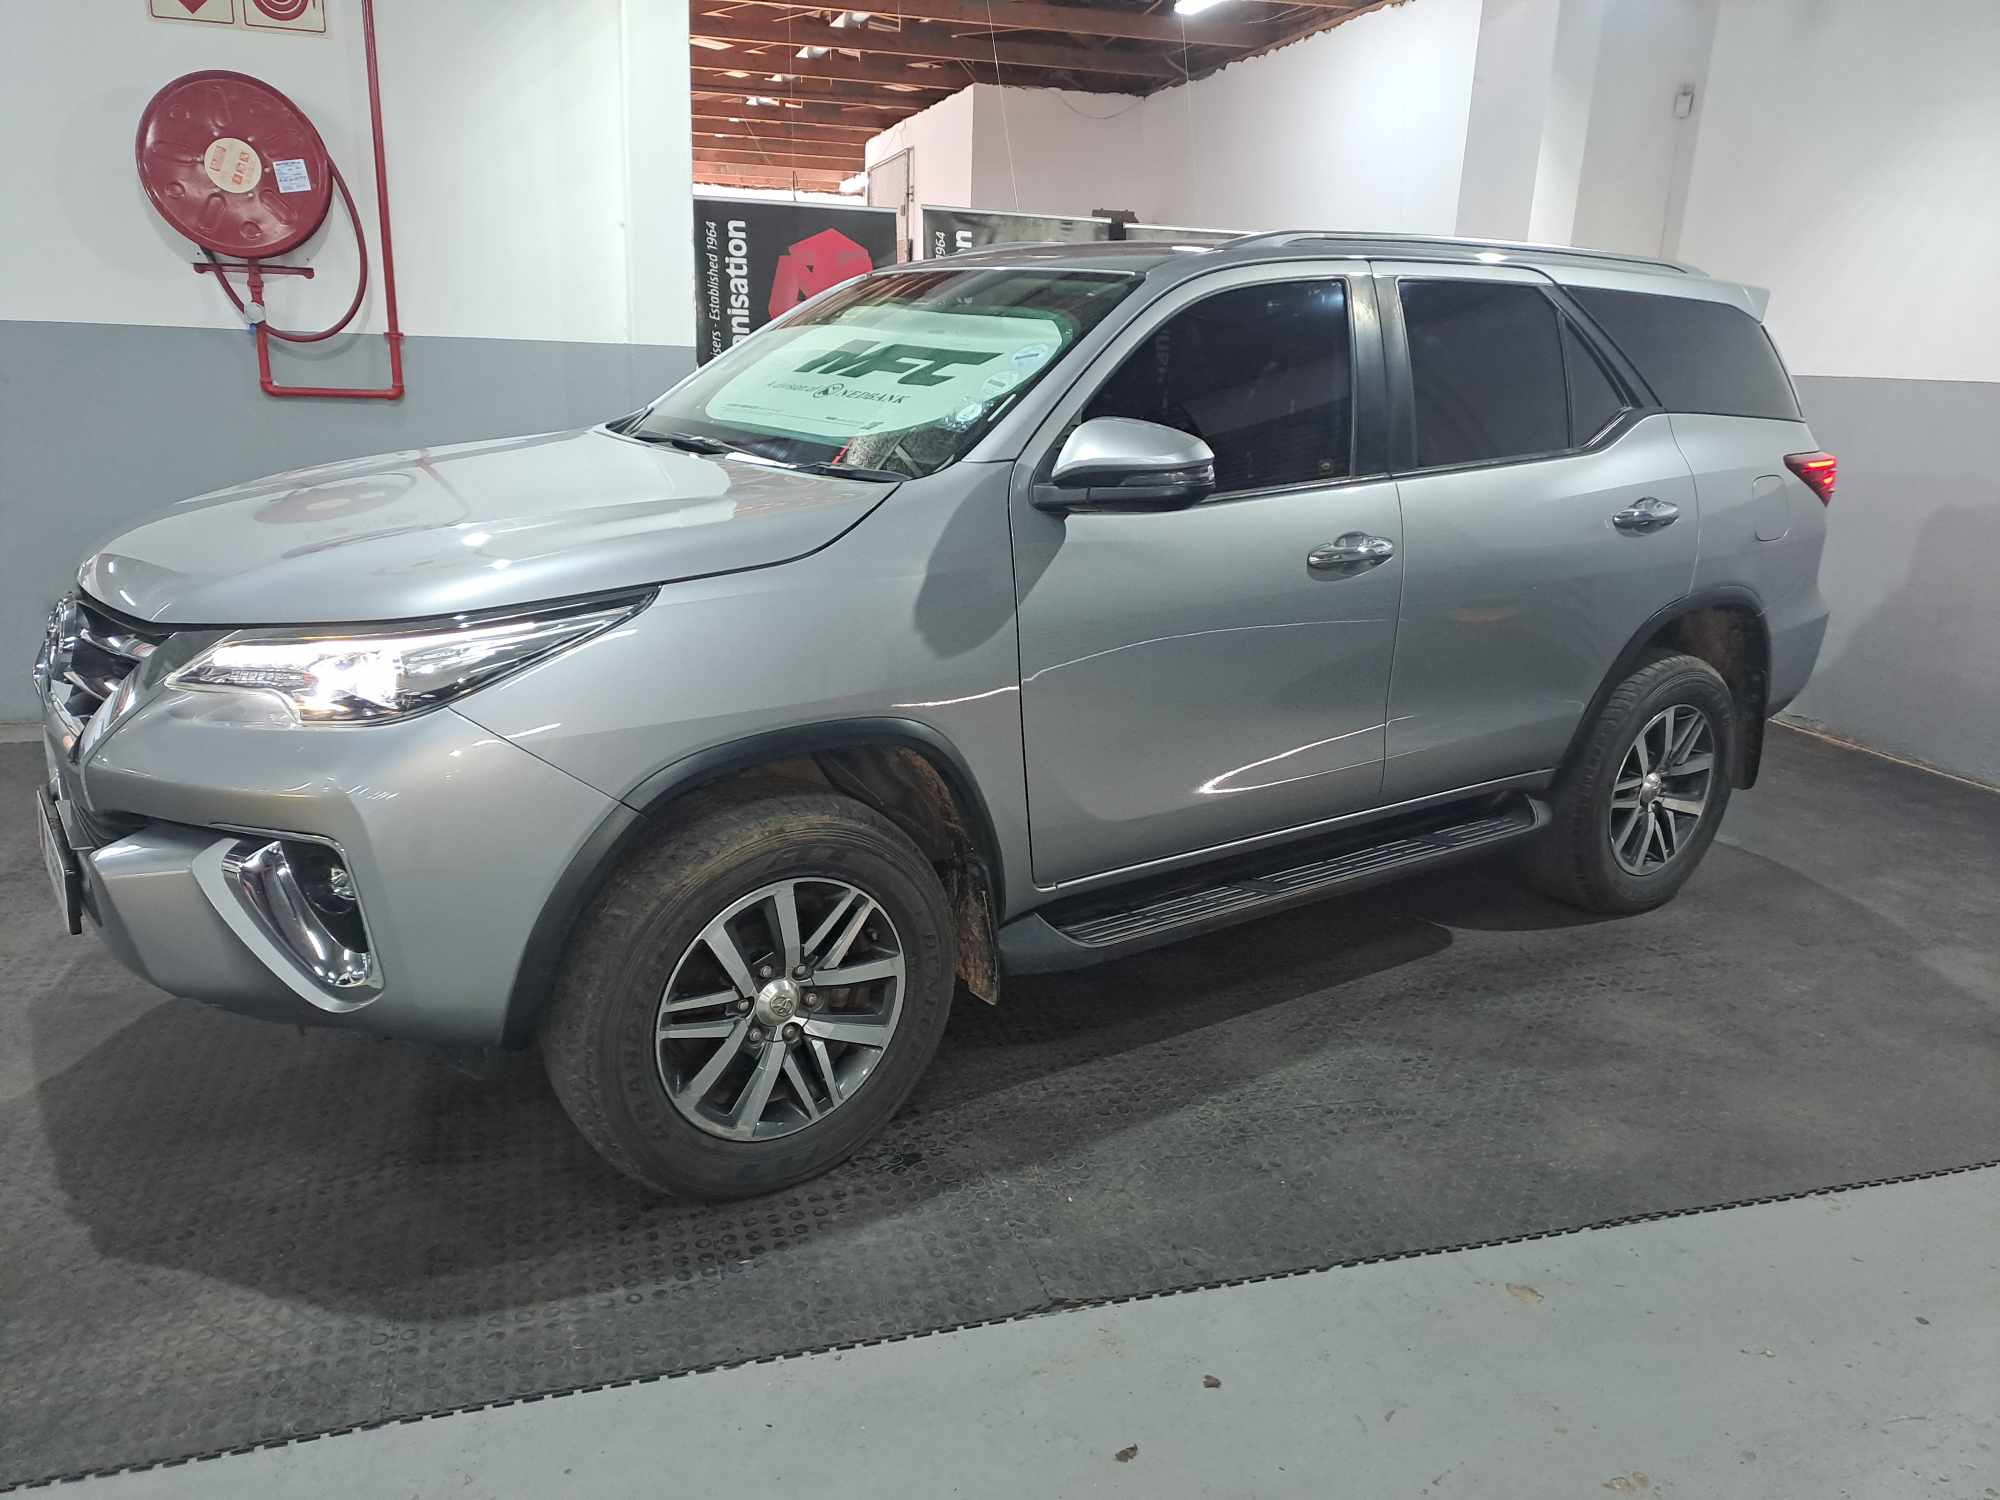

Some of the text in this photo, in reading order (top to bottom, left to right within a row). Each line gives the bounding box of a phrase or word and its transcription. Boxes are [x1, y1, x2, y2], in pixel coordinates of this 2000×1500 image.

[705, 221, 718, 250] 1964
[956, 230, 972, 252] n
[706, 253, 720, 320] Established
[710, 331, 721, 358] isers
